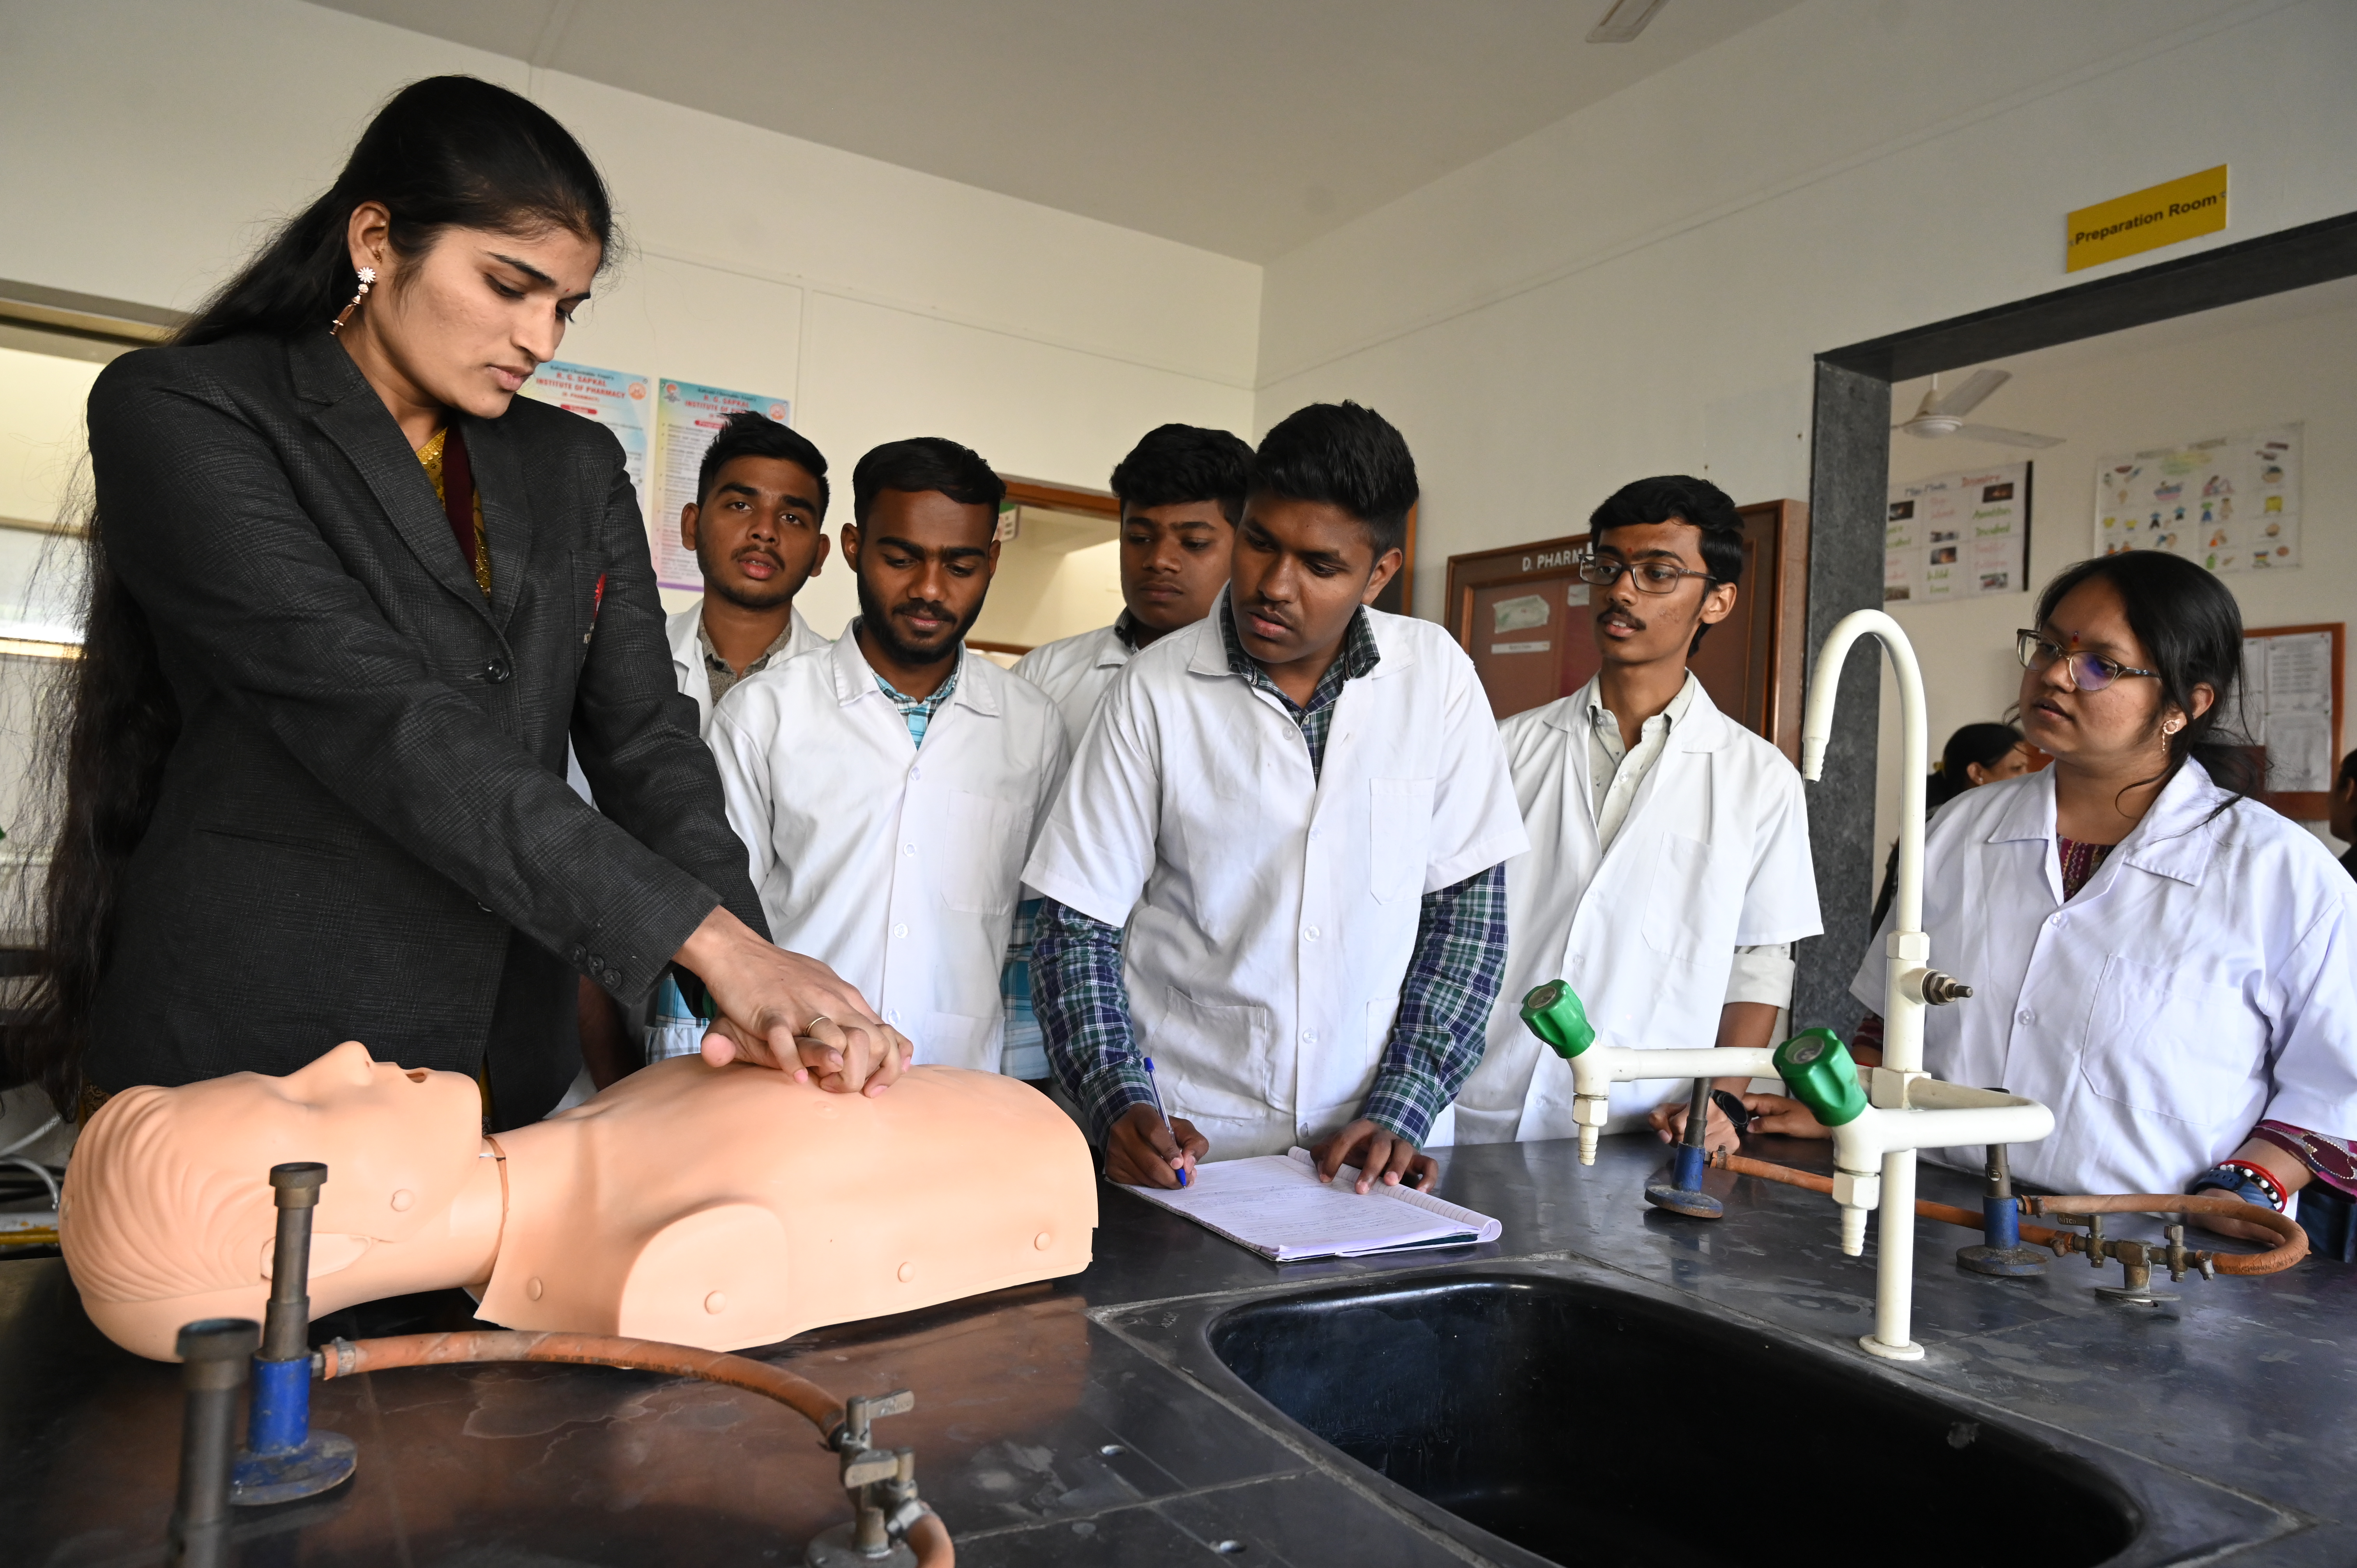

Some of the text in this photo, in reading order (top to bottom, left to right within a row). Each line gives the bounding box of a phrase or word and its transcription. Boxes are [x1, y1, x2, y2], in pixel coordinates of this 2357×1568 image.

[2074, 194, 2217, 245] Preparation Room
[536, 378, 572, 389] INSTITUTE
[586, 386, 625, 399] PHARMACY
[578, 376, 606, 386] SAPKAL
[685, 400, 718, 411] INSTITUTE
[723, 397, 749, 408] SAPKAL
[1537, 547, 1583, 569] PHARM
